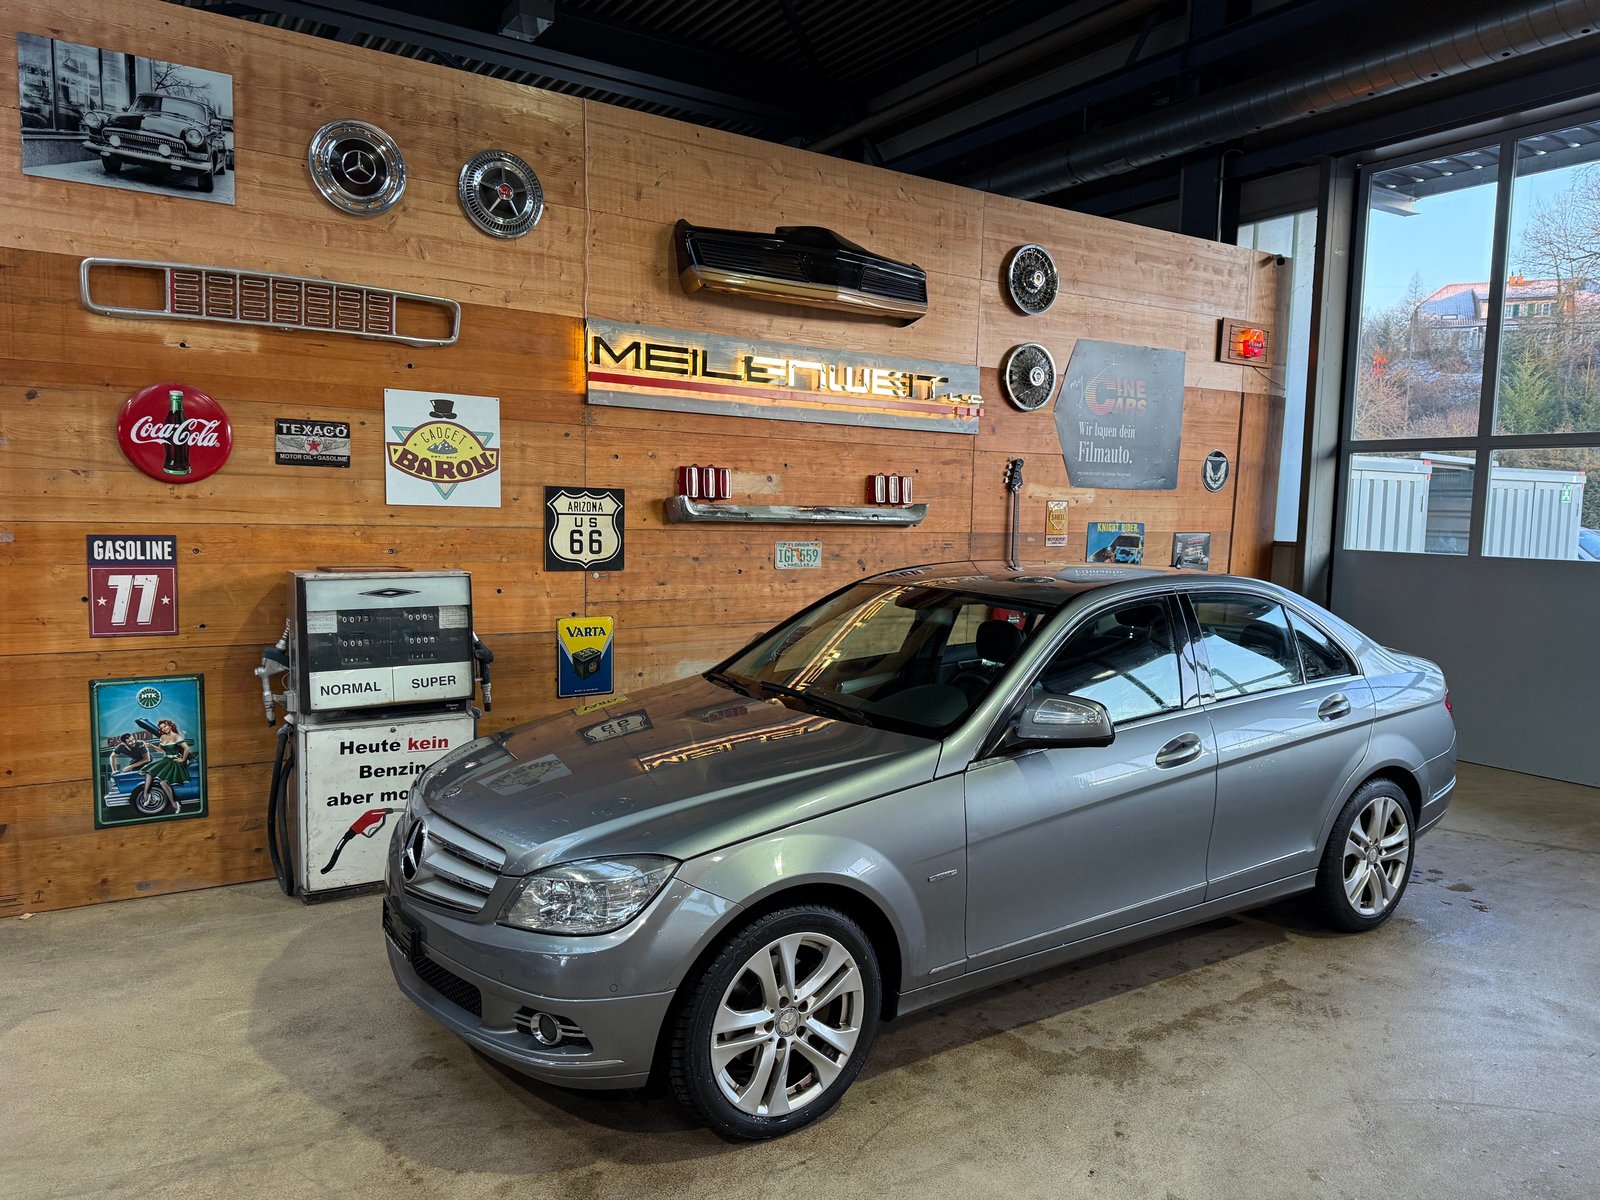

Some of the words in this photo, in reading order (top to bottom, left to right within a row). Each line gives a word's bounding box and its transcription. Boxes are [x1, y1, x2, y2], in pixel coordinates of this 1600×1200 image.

[591, 335, 949, 400] MEILENWEIT
[130, 415, 222, 447] Coca-Cola
[279, 423, 348, 437] TEXACO
[420, 426, 468, 445] GADGET
[1078, 421, 1093, 436] Wir
[1094, 422, 1117, 438] bauen
[1118, 424, 1136, 438] dein
[1078, 441, 1133, 464] Filmauto.
[394, 447, 495, 479] BARON
[567, 501, 604, 513] ARIZONA
[1097, 522, 1119, 532] KNIGHT
[93, 540, 172, 560] GASOLINE
[569, 529, 603, 555] 66
[800, 548, 819, 563] 559
[107, 574, 160, 626] 77
[565, 626, 606, 638] VARTA
[320, 681, 382, 697] NORMAL
[411, 674, 457, 690] SUPER
[339, 739, 401, 755] Heute
[408, 735, 449, 751] kein
[359, 761, 426, 779] Benzin
[326, 792, 374, 807] aber
[380, 789, 410, 802] mo
